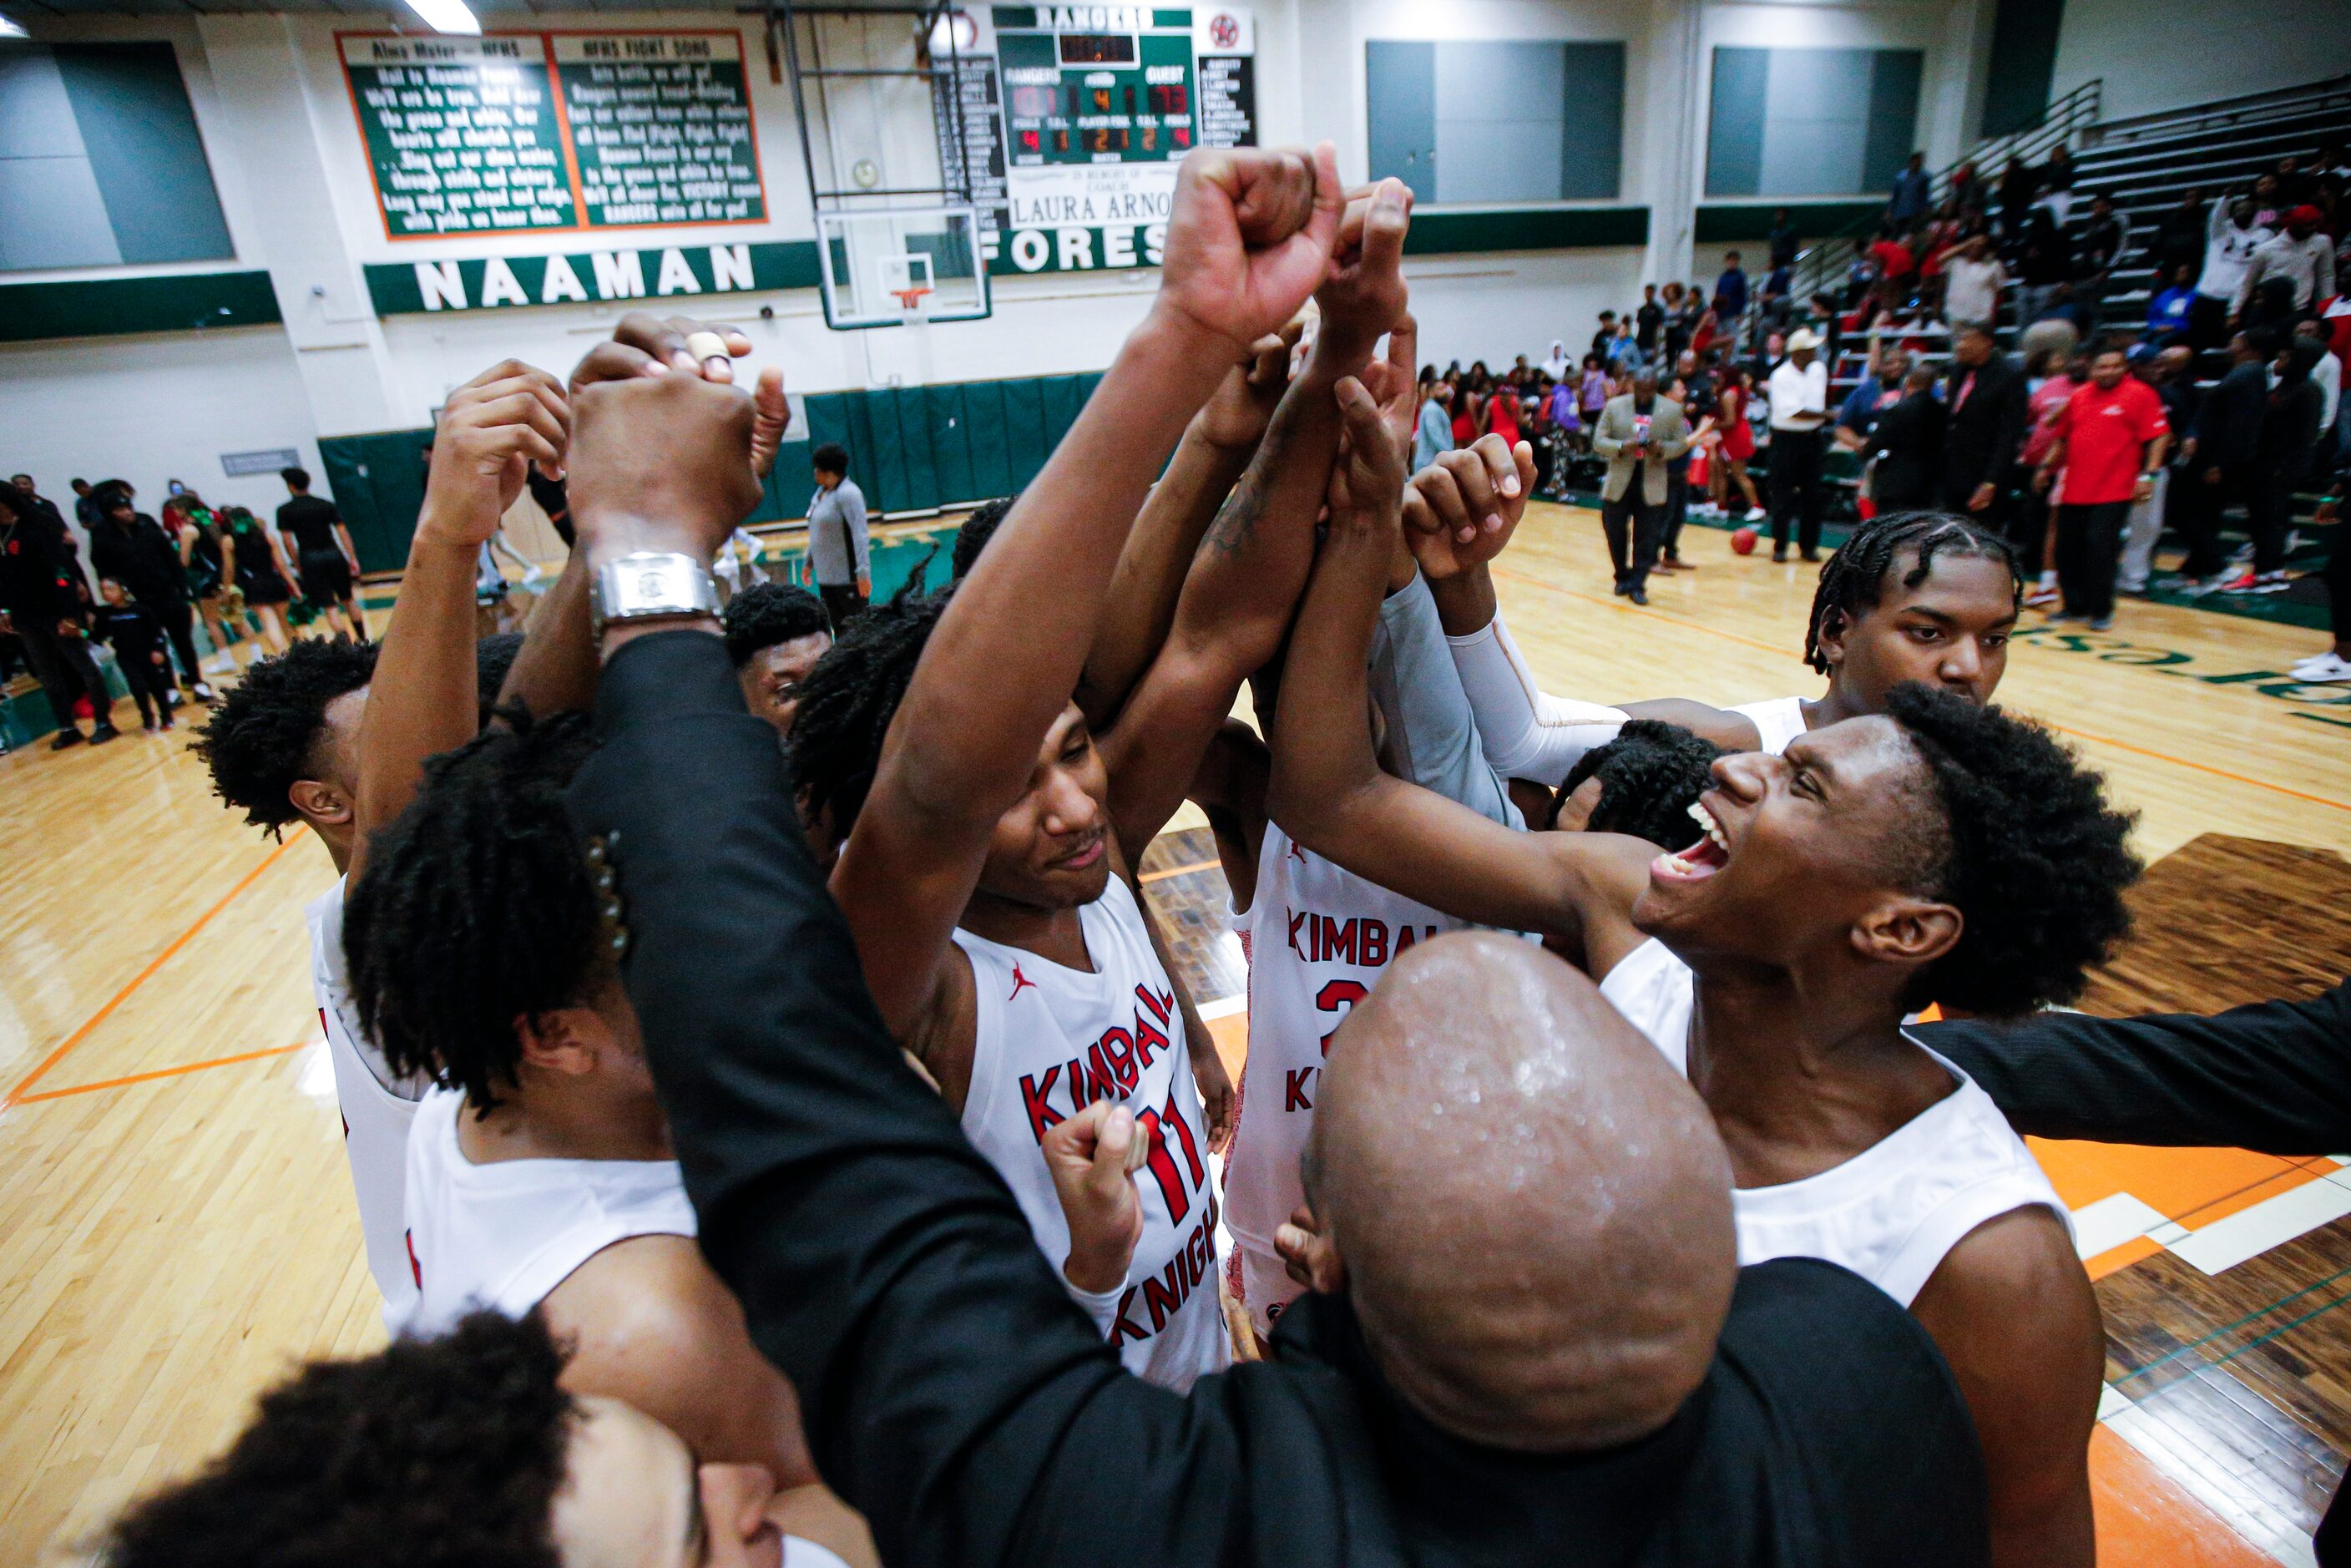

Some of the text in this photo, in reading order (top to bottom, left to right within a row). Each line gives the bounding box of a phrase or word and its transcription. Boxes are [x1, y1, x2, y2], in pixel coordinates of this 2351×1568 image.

[1036, 6, 1154, 31] RANGERS
[372, 41, 407, 59] Alma
[414, 40, 455, 58] Mater
[1145, 66, 1184, 84] GUEST
[1095, 89, 1110, 112] 4
[1022, 130, 1039, 152] 4
[1088, 182, 1129, 193] COACH
[1014, 196, 1095, 224] LAURA
[413, 243, 756, 311] NAAMAN
[1287, 906, 1438, 967] KIMBA
[1286, 1066, 1322, 1113] K
[1135, 1072, 1206, 1229] 11
